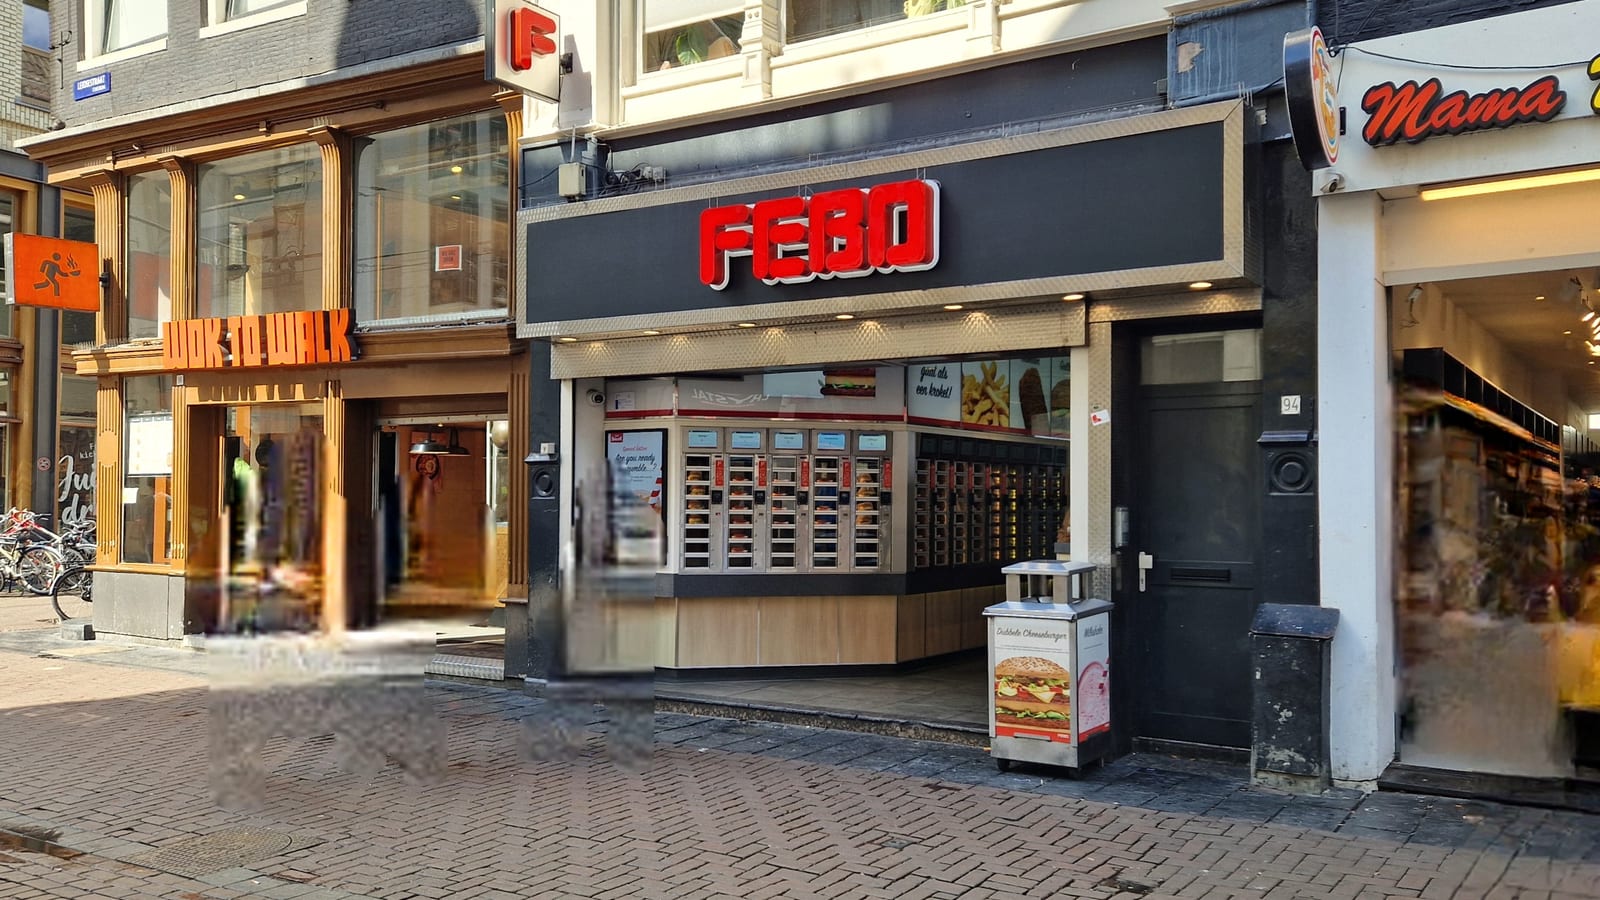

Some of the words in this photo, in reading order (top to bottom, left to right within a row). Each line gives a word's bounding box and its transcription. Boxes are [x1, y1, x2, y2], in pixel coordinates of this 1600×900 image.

[510, 7, 556, 71] F
[1362, 77, 1566, 145] Mama
[699, 179, 940, 290] FEBO
[162, 318, 224, 369] WOK
[227, 315, 263, 367] TO
[266, 307, 353, 366] WALK
[1283, 397, 1298, 411] 94
[626, 455, 637, 465] you
[637, 452, 656, 465] ready
